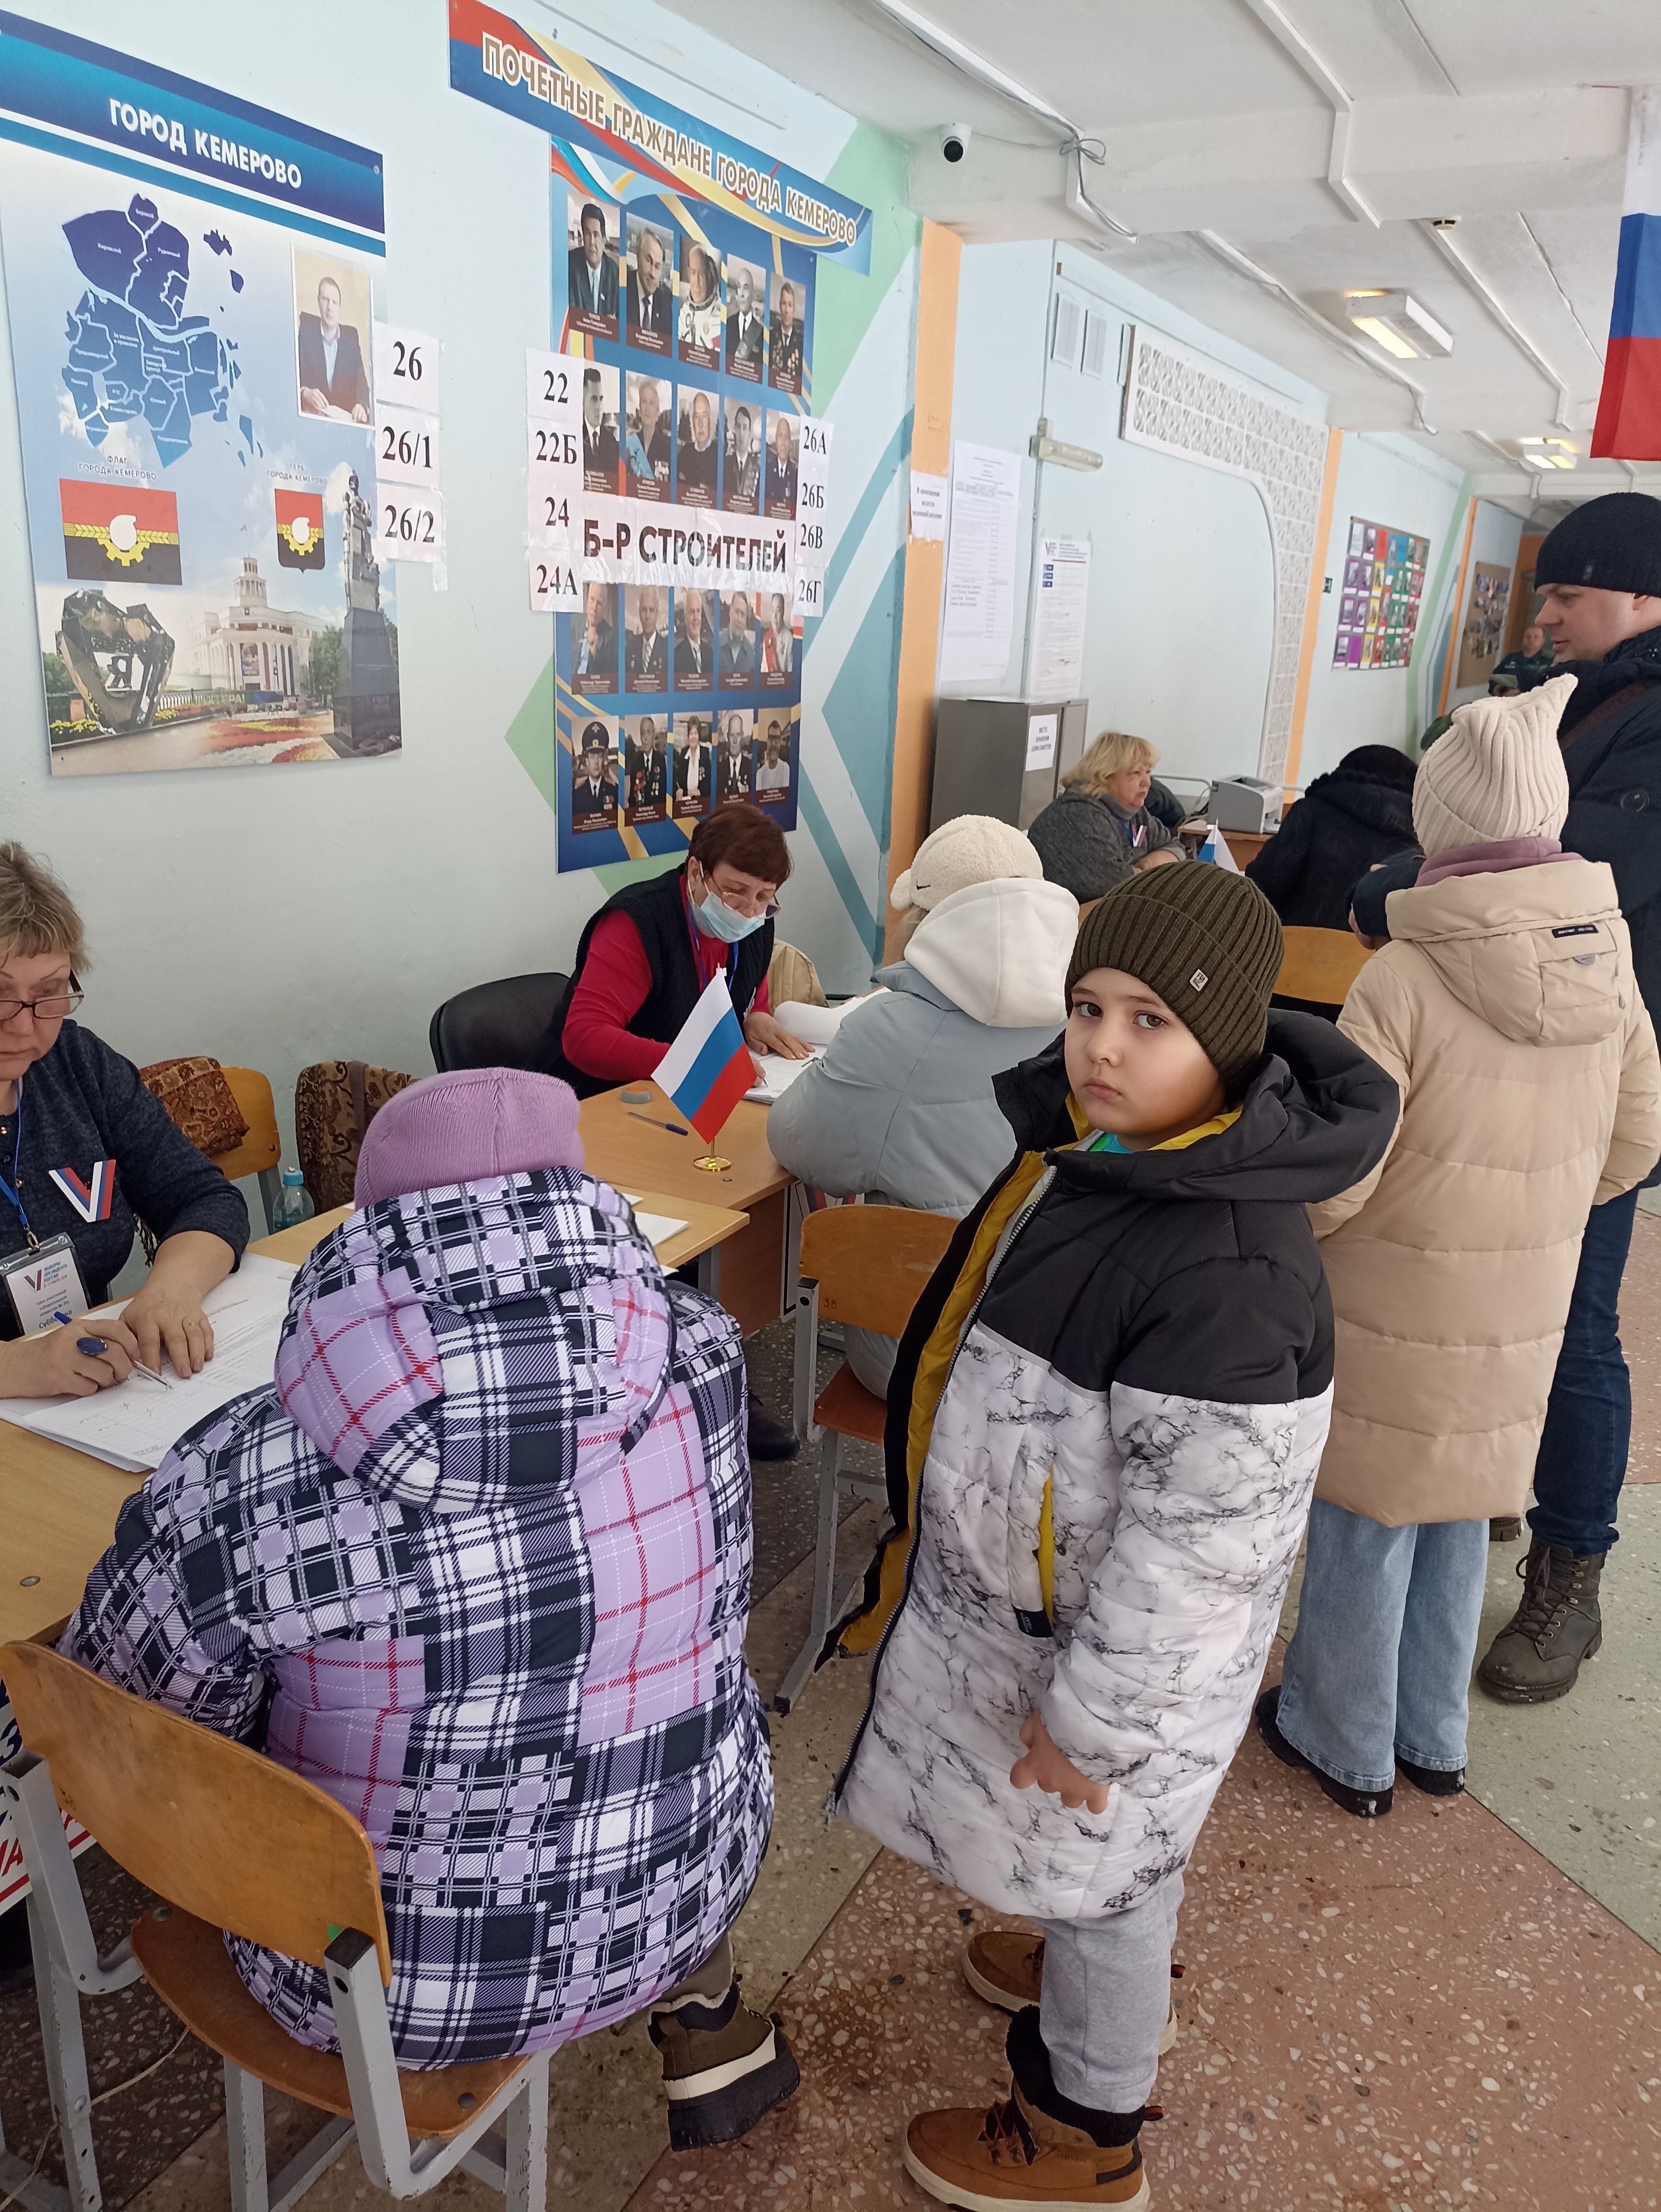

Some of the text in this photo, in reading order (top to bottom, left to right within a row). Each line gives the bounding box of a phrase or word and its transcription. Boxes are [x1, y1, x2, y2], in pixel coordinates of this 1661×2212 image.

[110, 98, 302, 189] ГОРОД КЕМЕРОВО
[484, 33, 855, 245] ПОЧЕТНЫЕ ГРАЖДАНЕ ГОРОДА КЕМЕРОВО
[393, 341, 422, 381] 26
[543, 370, 568, 404] 22
[382, 426, 433, 469] 26/1
[535, 431, 577, 465] 22Б
[803, 425, 827, 455] 26А
[78, 463, 156, 480] ГОРОДА КЕМЕРОВО
[107, 455, 128, 464] ФЛАГ
[267, 470, 328, 485] ГОРОДА КЕМЕРОВО
[801, 482, 824, 509] 26Б
[384, 505, 435, 543] 26/2
[545, 497, 569, 527] 24
[584, 519, 786, 573] Б-Р СТРОИТЕЛЕЙ
[800, 523, 823, 549] 26В
[536, 564, 578, 595] 24А
[798, 579, 822, 604] 26Г
